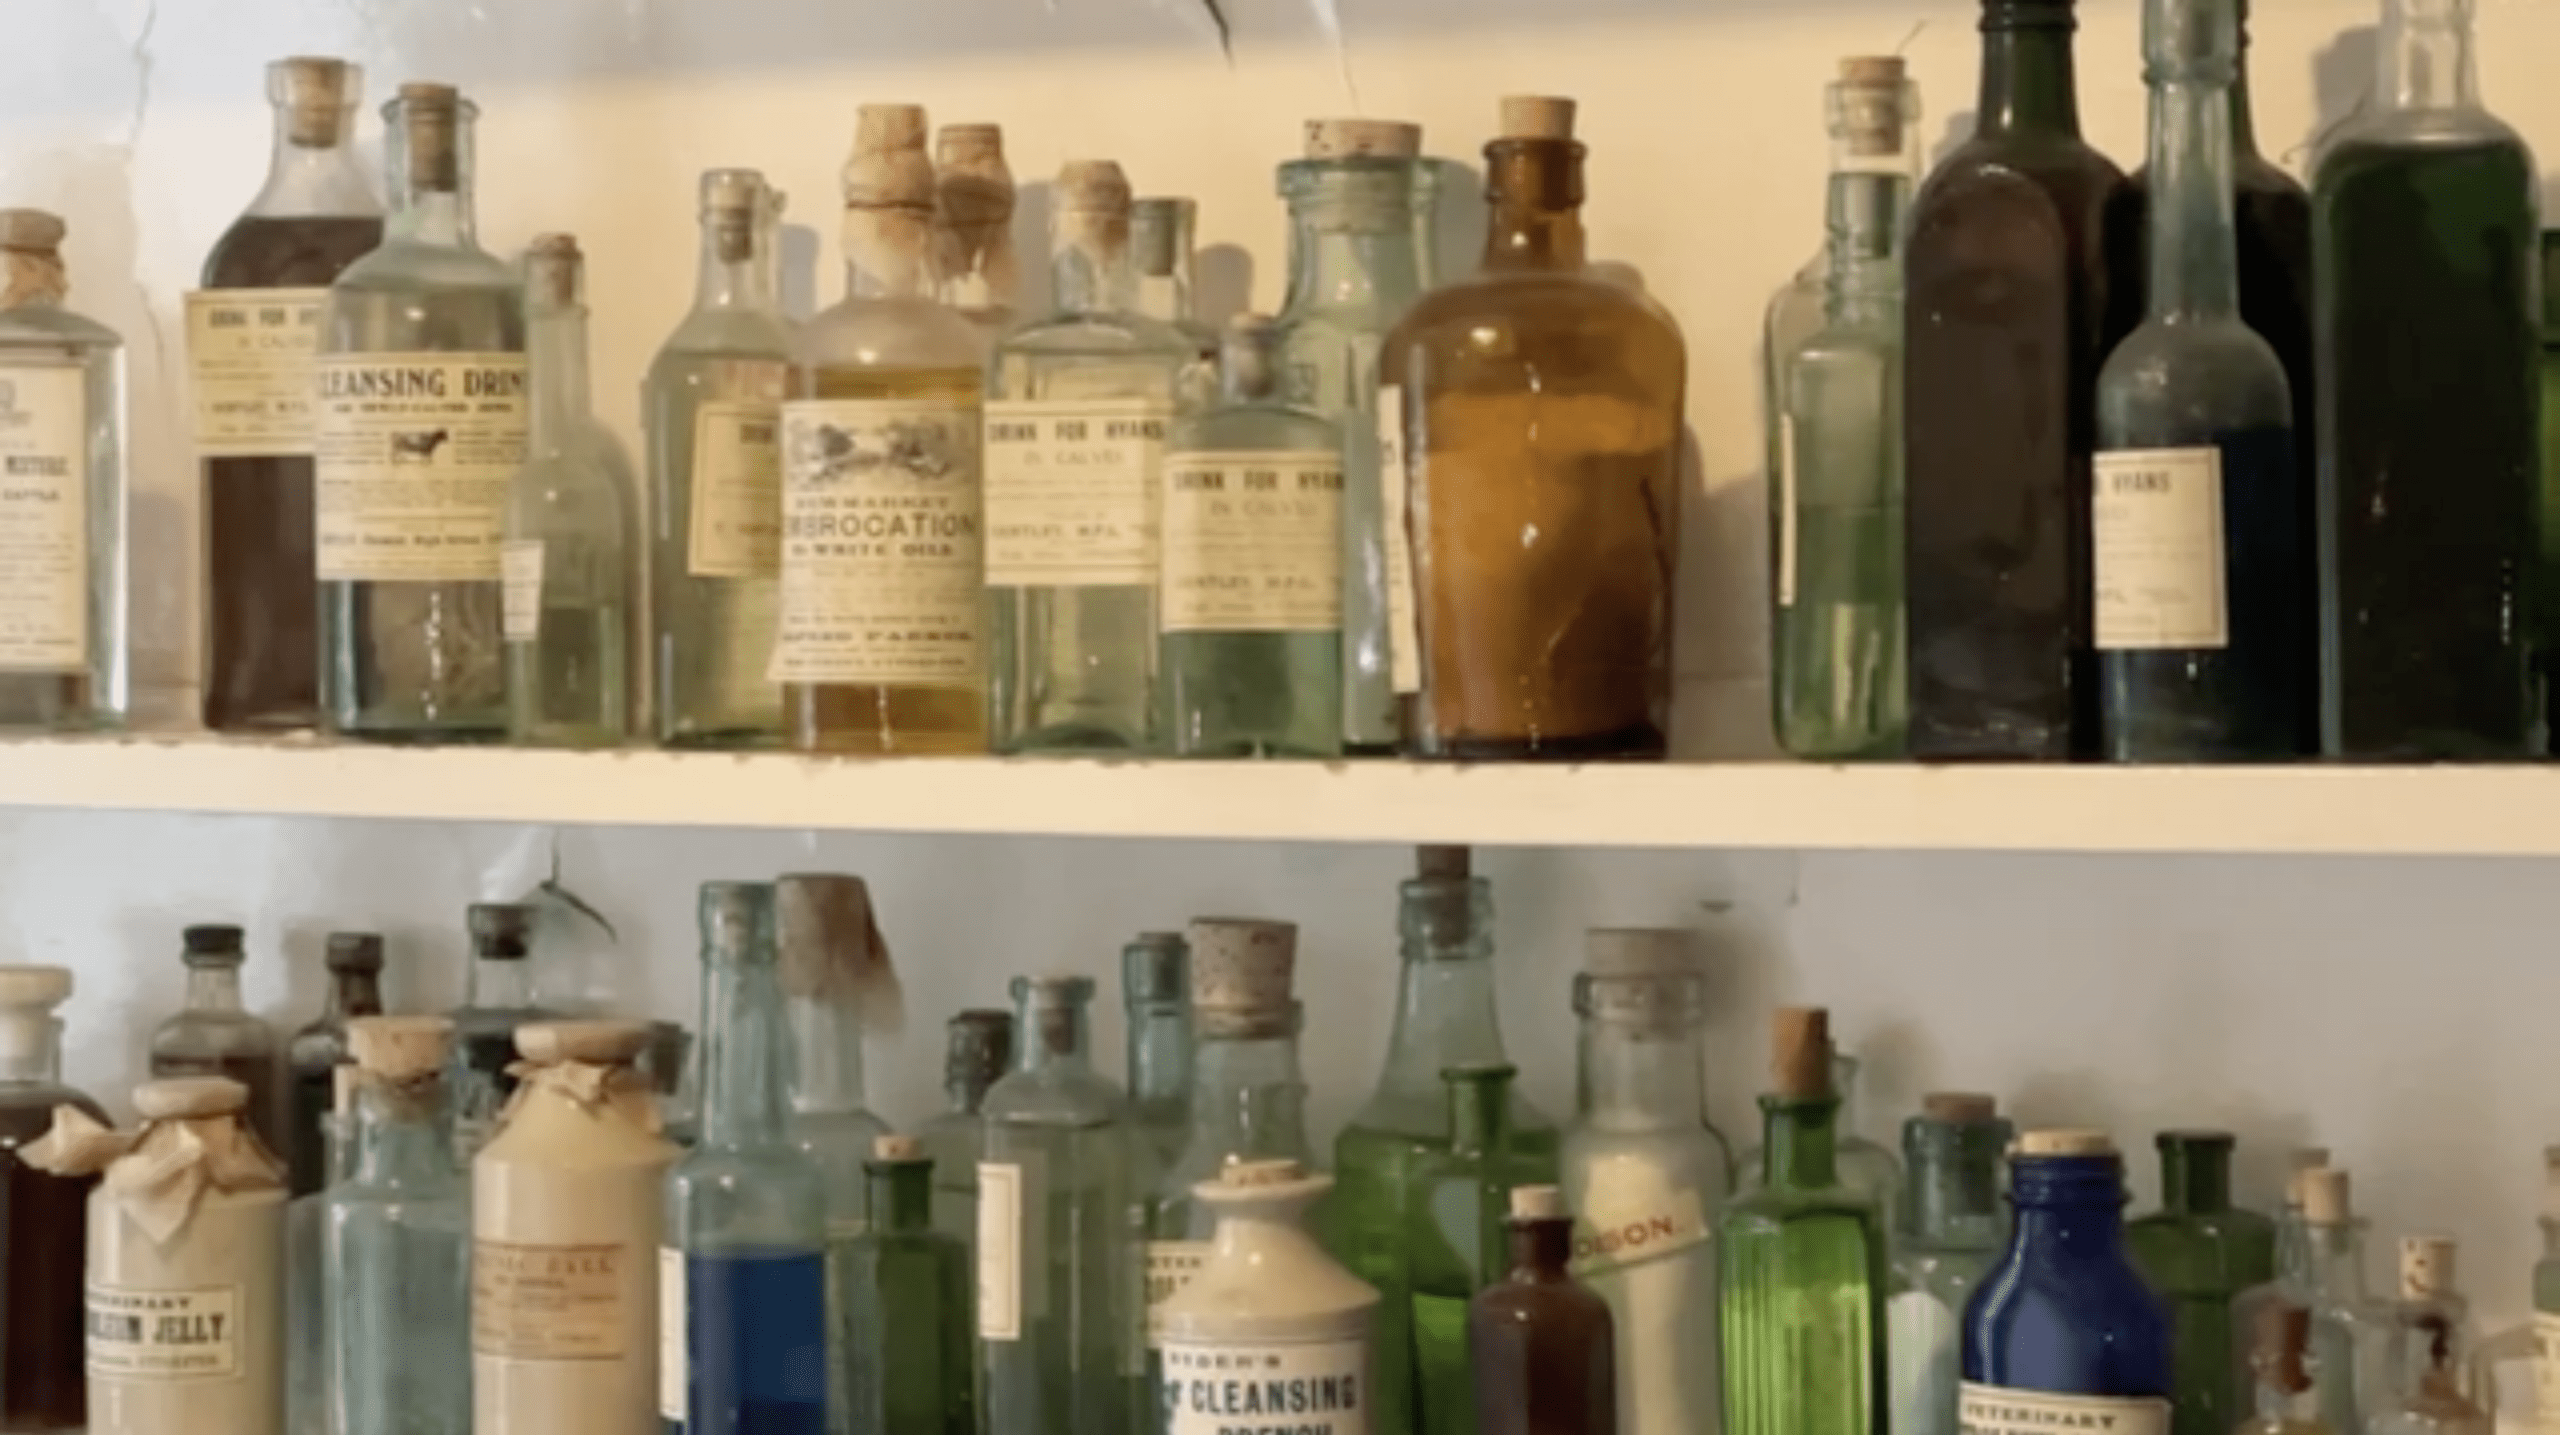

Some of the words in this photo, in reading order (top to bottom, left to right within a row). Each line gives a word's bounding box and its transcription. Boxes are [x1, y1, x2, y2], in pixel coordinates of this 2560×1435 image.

[319, 368, 445, 397] LEANSING
[462, 368, 525, 396] DRIN
[1055, 420, 1088, 441] FOR
[1244, 471, 1277, 490] FOR
[1576, 1214, 1687, 1257] OISON.
[154, 1311, 224, 1345] JELLY
[1191, 1375, 1357, 1416] CLEANSING
